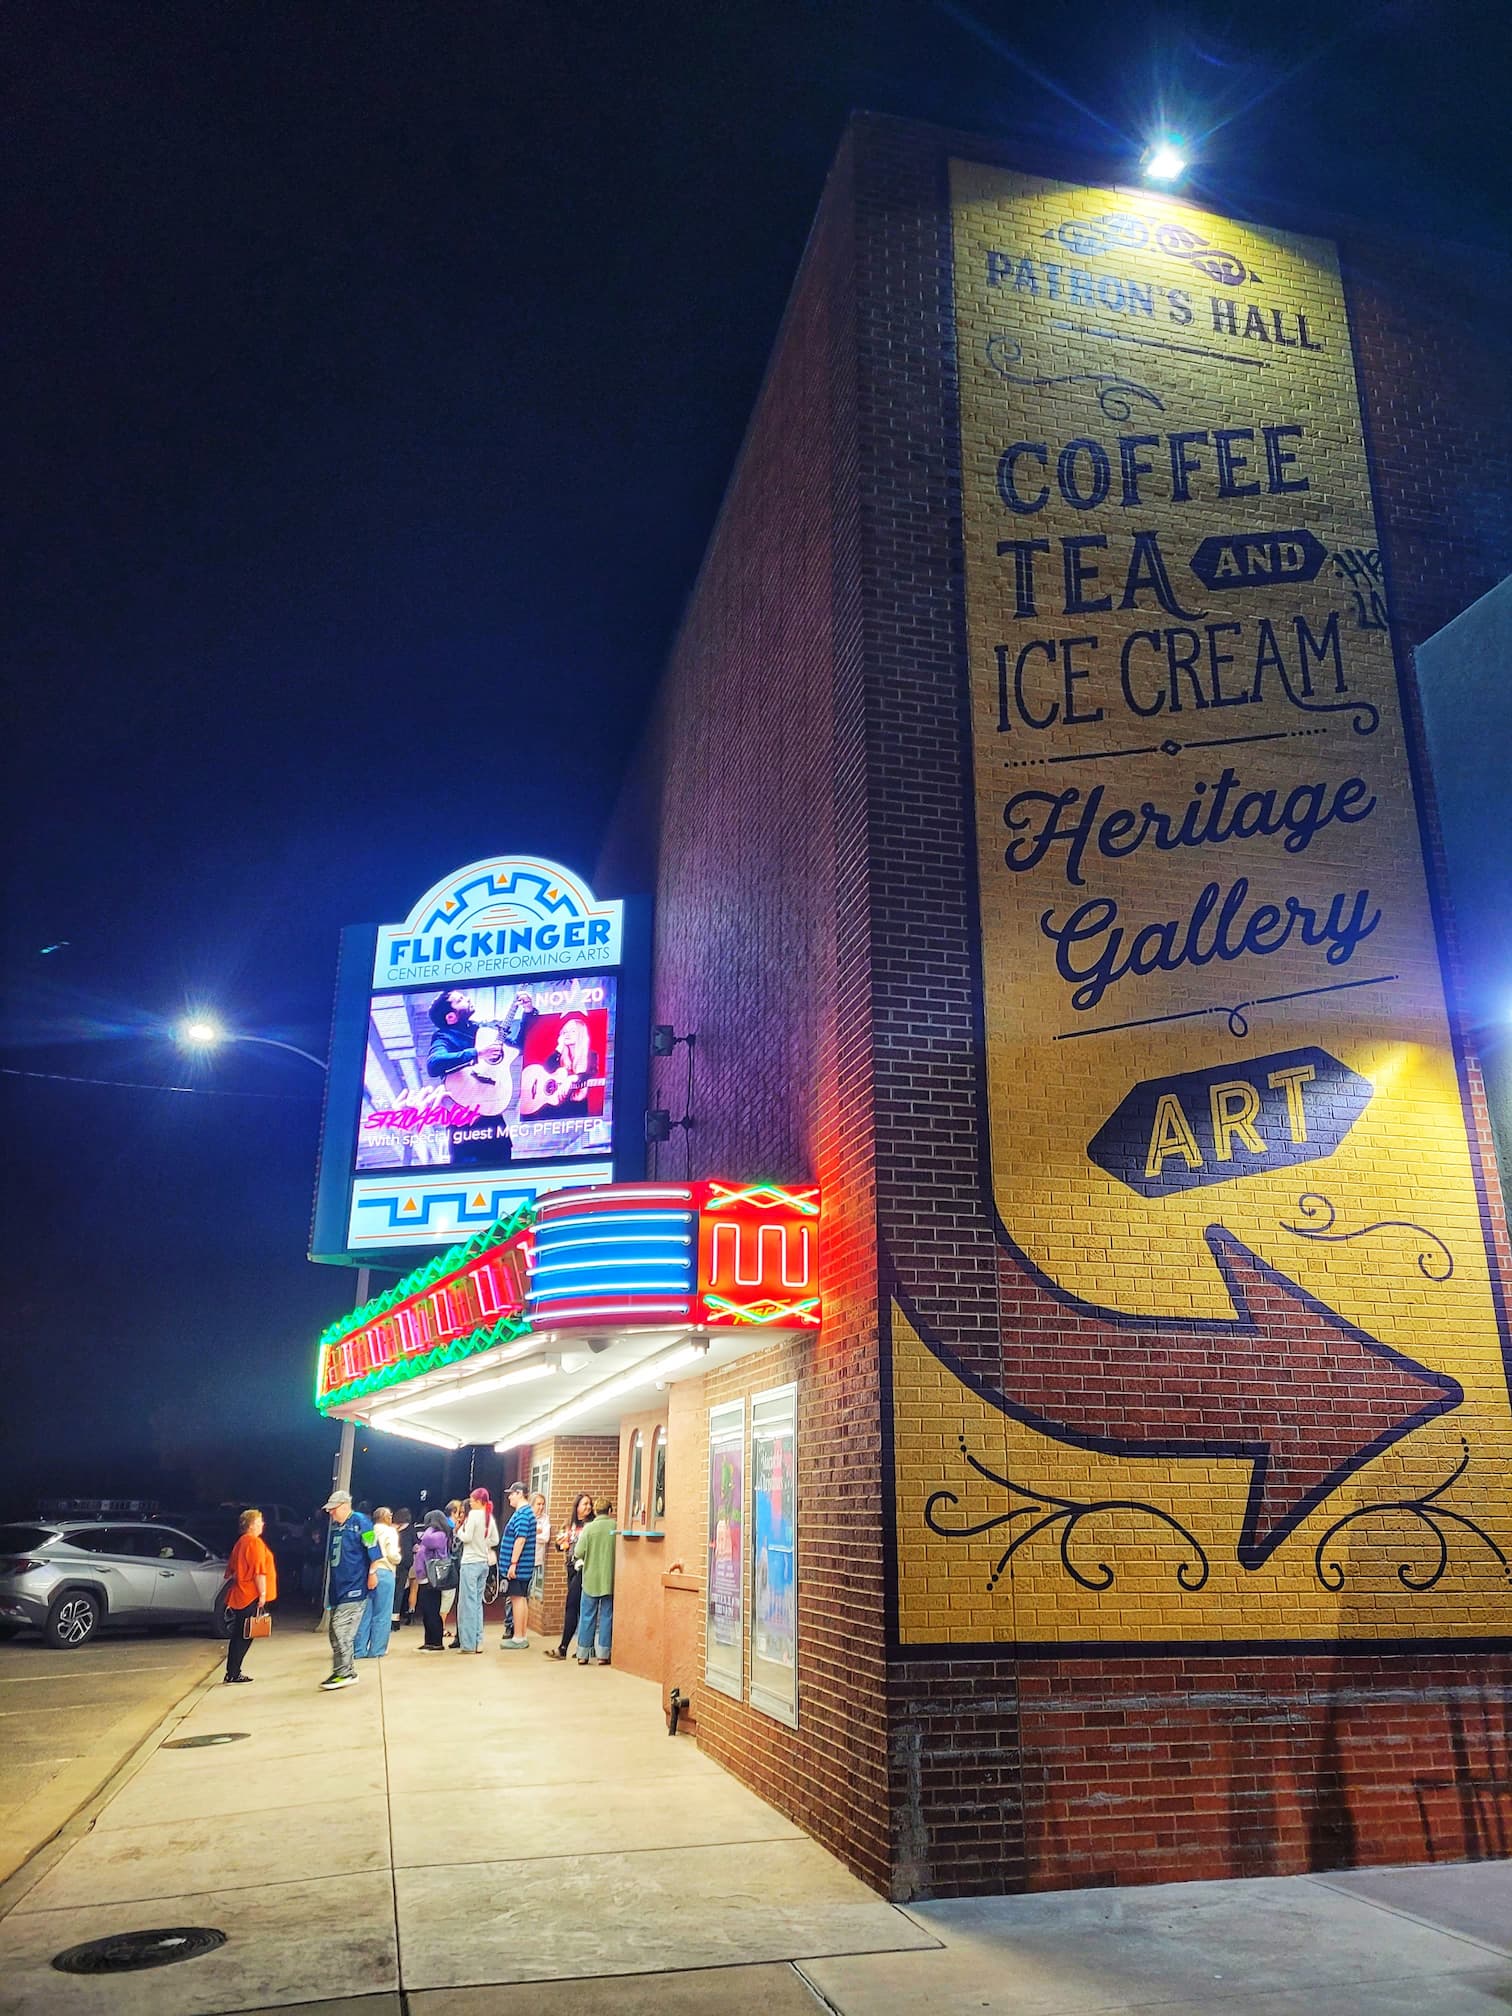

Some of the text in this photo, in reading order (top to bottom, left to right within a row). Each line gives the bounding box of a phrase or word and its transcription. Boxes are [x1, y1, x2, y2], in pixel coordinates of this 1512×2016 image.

[984, 250, 1324, 353] PATRON'S HALL
[996, 424, 1310, 515] COFFEE
[996, 530, 1208, 621] TEA
[1213, 538, 1306, 580] AND
[994, 611, 1381, 736] ICE CREAM
[1003, 767, 1377, 885] Heritage
[387, 946, 611, 981] CENTER FOR PERFORMING ARTS
[389, 919, 611, 966] FLICKINGER
[1040, 877, 1381, 1011] Gallery
[535, 986, 604, 1007] NOV 20
[402, 1128, 450, 1147] special
[452, 1126, 493, 1144] guest
[496, 1124, 529, 1139] MEG
[533, 1119, 603, 1137] PFEIFFER
[1145, 1064, 1318, 1178] ART
